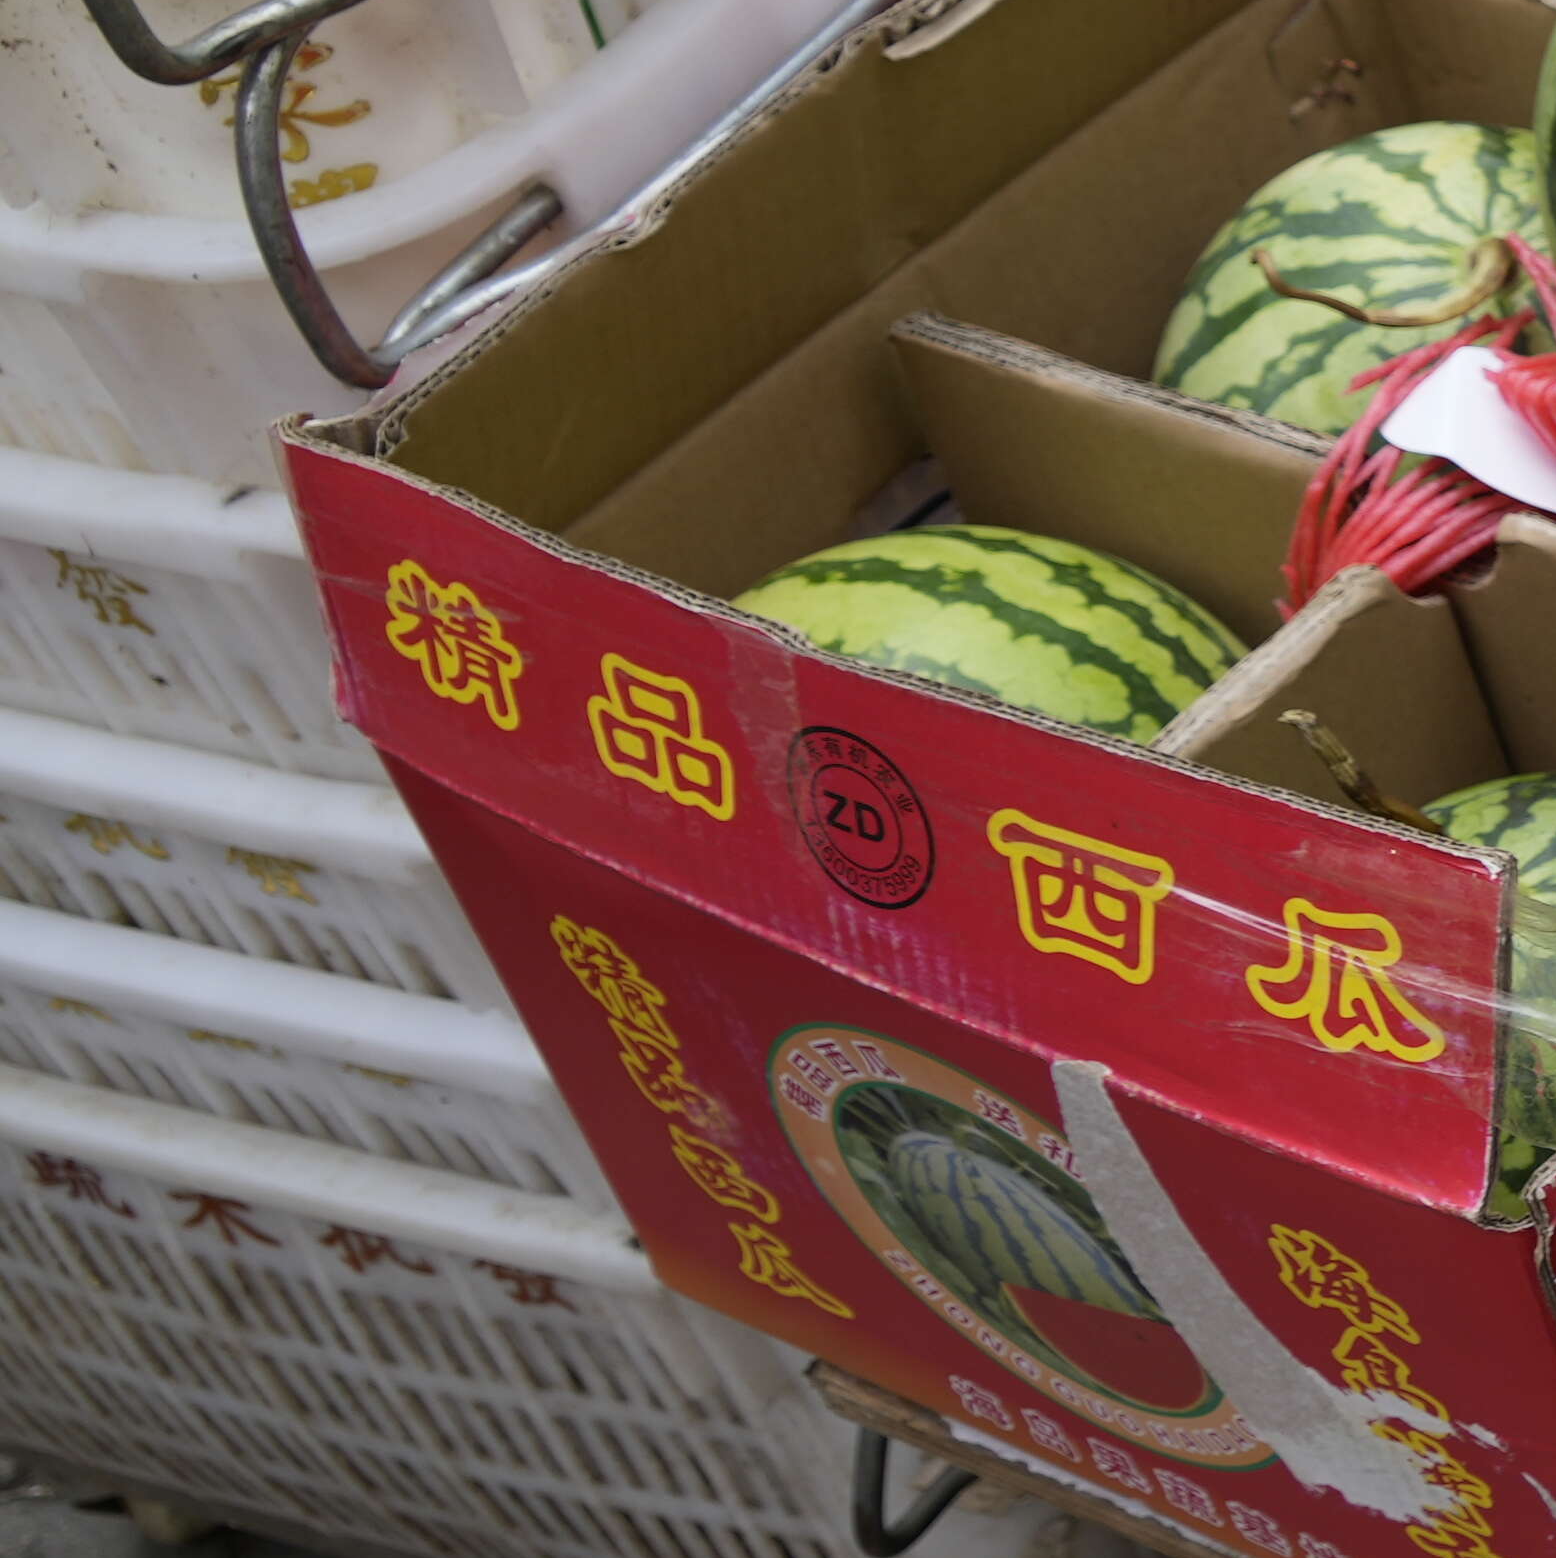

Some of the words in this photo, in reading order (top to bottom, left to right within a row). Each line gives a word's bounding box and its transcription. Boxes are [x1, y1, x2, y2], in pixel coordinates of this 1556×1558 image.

[385, 558, 737, 823] 精品
[985, 807, 1447, 1064] 西瓜
[822, 789, 885, 843] ZD
[549, 913, 856, 1320] 精品西瓜
